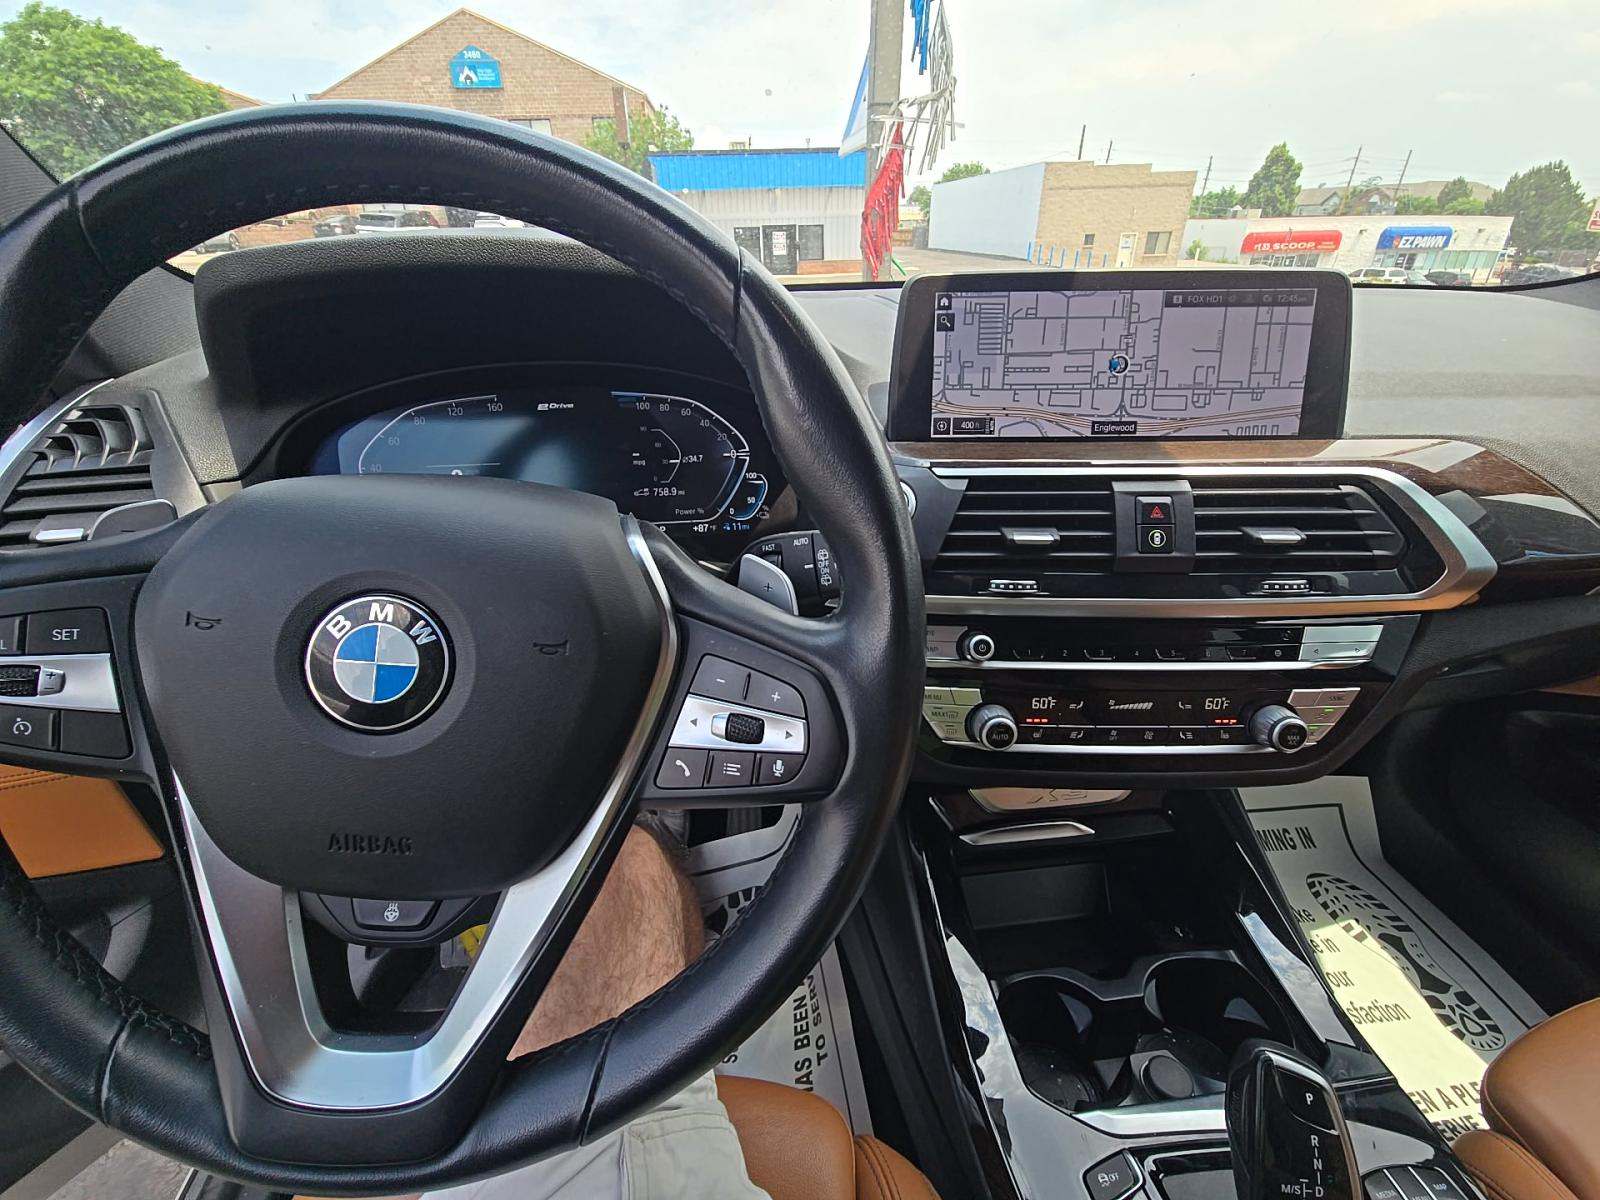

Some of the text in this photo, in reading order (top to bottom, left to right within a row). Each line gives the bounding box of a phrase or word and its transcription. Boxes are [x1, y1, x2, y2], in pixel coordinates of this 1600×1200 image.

[1187, 295, 1223, 303] FOX HD1
[448, 407, 464, 416] 120
[487, 403, 503, 412] 160
[636, 402, 650, 411] 100
[660, 403, 670, 412] 80
[681, 408, 692, 416] 60
[414, 416, 426, 426] 80
[700, 420, 710, 428] 40
[961, 421, 975, 430] 400
[1094, 423, 1136, 433] Englewood
[388, 436, 400, 446] 60
[717, 433, 728, 441] 20
[370, 463, 382, 472] 40
[653, 487, 678, 497] 758.9
[747, 497, 756, 505] 50
[692, 523, 708, 533] +87
[793, 537, 809, 546] AUTO
[762, 543, 776, 552] FAST
[326, 602, 437, 647] BMW
[52, 628, 80, 641] SET
[1295, 826, 1317, 849] IN
[327, 832, 413, 854] AIRBAG
[1315, 933, 1341, 953] in
[793, 994, 811, 1051] BEEN
[815, 1033, 828, 1067] TO
[1305, 1092, 1314, 1105] P
[1435, 1087, 1458, 1110] A
[1310, 1134, 1320, 1147] R
[1313, 1158, 1323, 1171] N
[1281, 1183, 1324, 1198] M/S D
